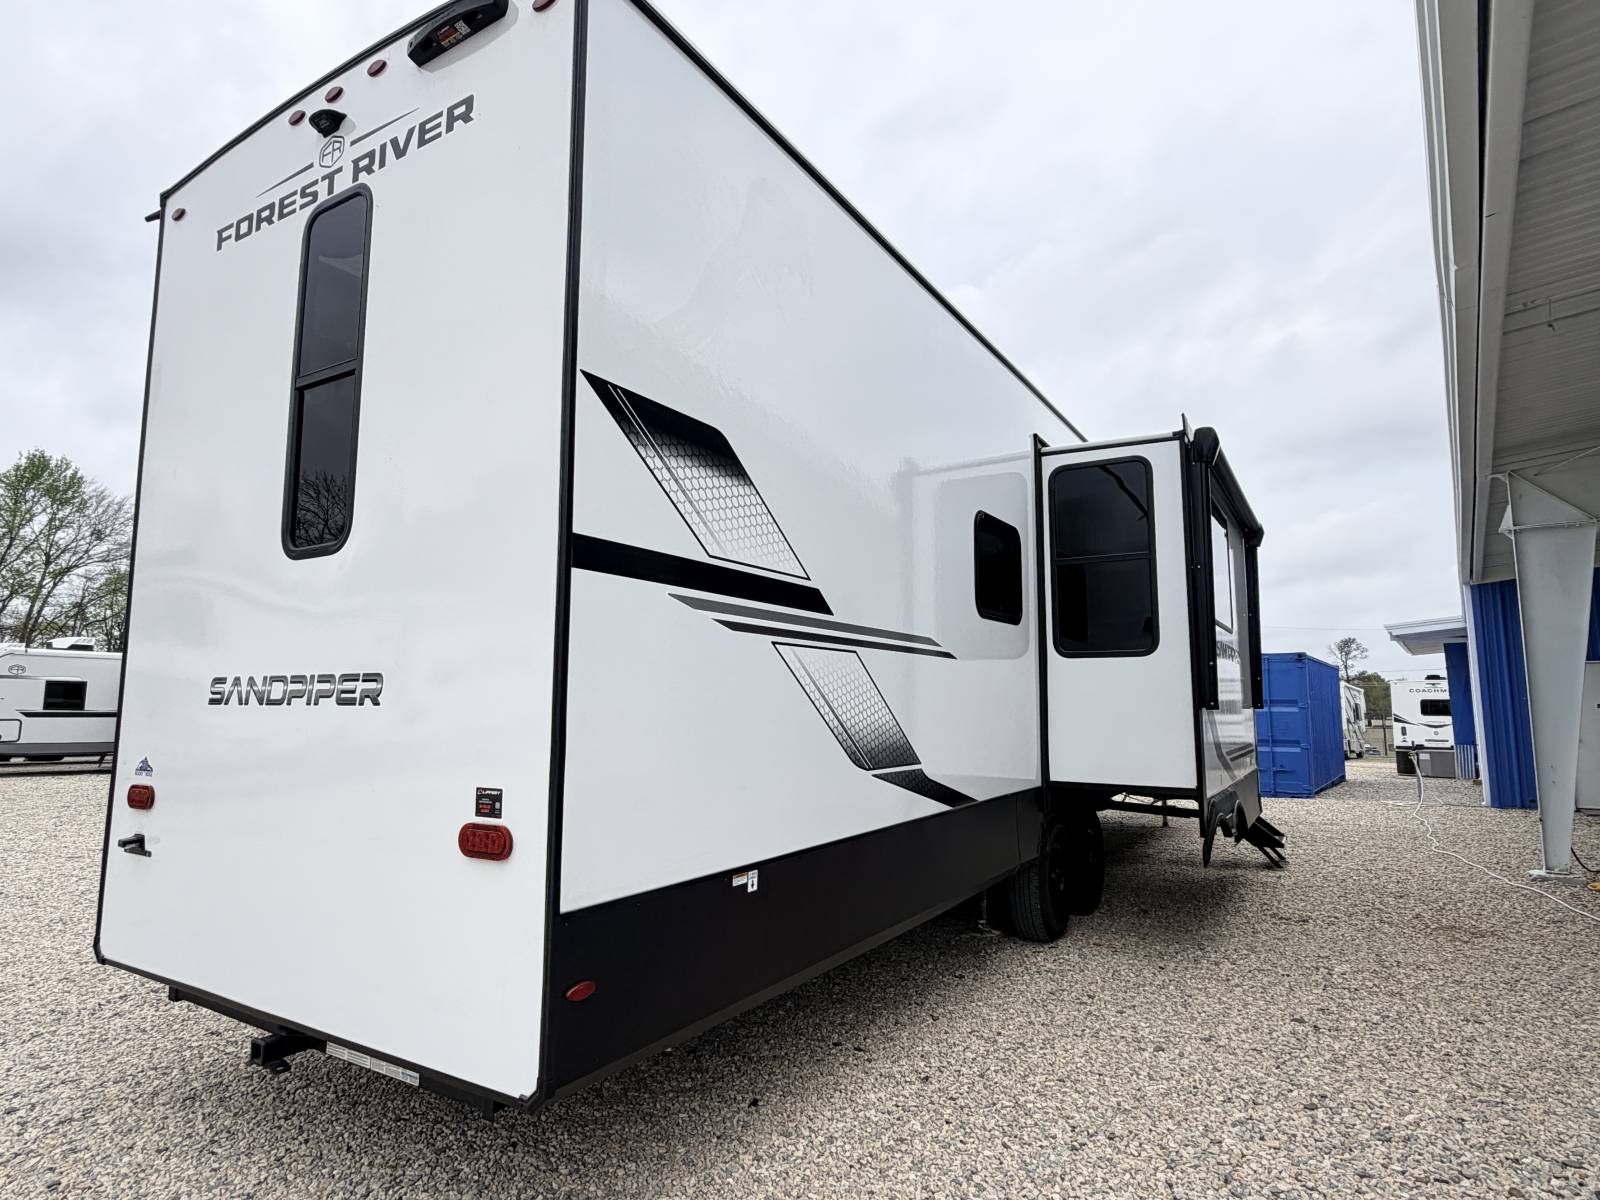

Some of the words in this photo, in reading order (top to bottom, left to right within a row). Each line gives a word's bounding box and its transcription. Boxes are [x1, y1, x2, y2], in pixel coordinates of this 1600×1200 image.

[216, 166, 343, 252] FOREST
[351, 94, 475, 184] RIVER
[208, 672, 384, 706] SANDPIPER
